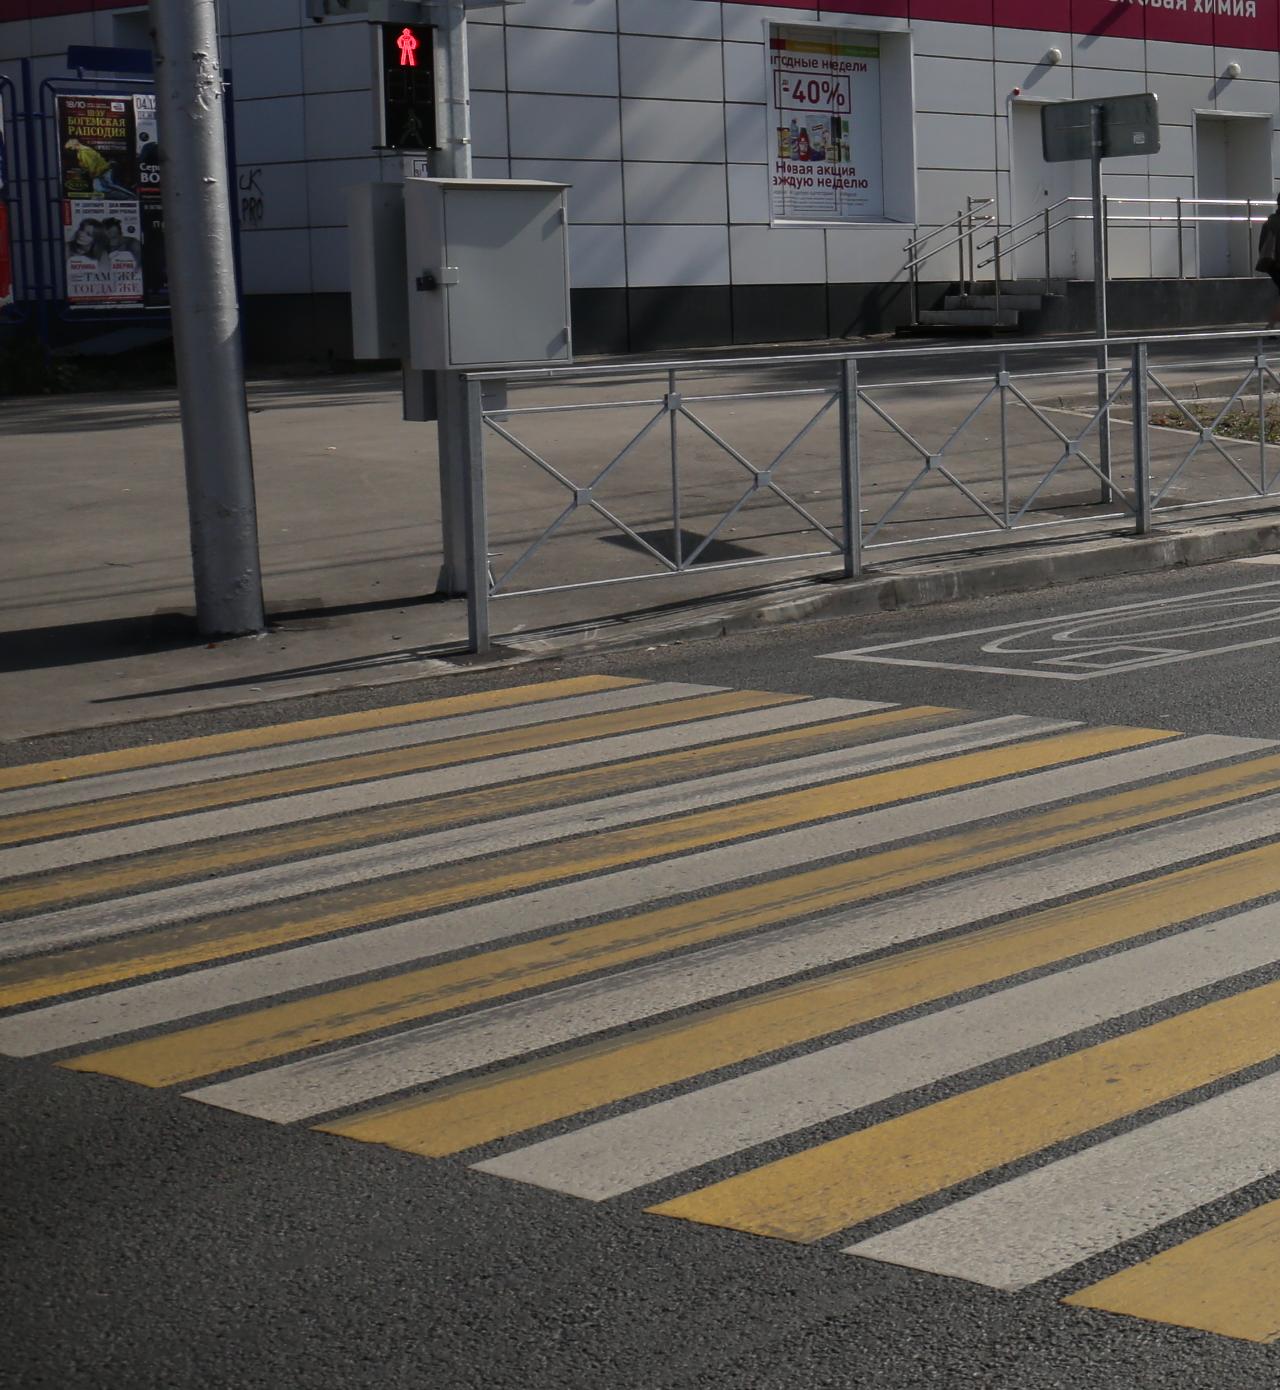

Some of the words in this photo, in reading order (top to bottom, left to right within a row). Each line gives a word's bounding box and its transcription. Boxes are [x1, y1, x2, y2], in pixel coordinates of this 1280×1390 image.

[770, 55, 819, 68] годные
[822, 60, 868, 72] недели
[68, 116, 126, 126] БОГЕМСКАЯ
[69, 127, 126, 137] РАПСОДИЯ
[776, 160, 813, 175] Новая
[816, 165, 856, 180] акция
[772, 175, 814, 190] аждую
[817, 178, 869, 190] неделю
[84, 271, 111, 283] ТАМ
